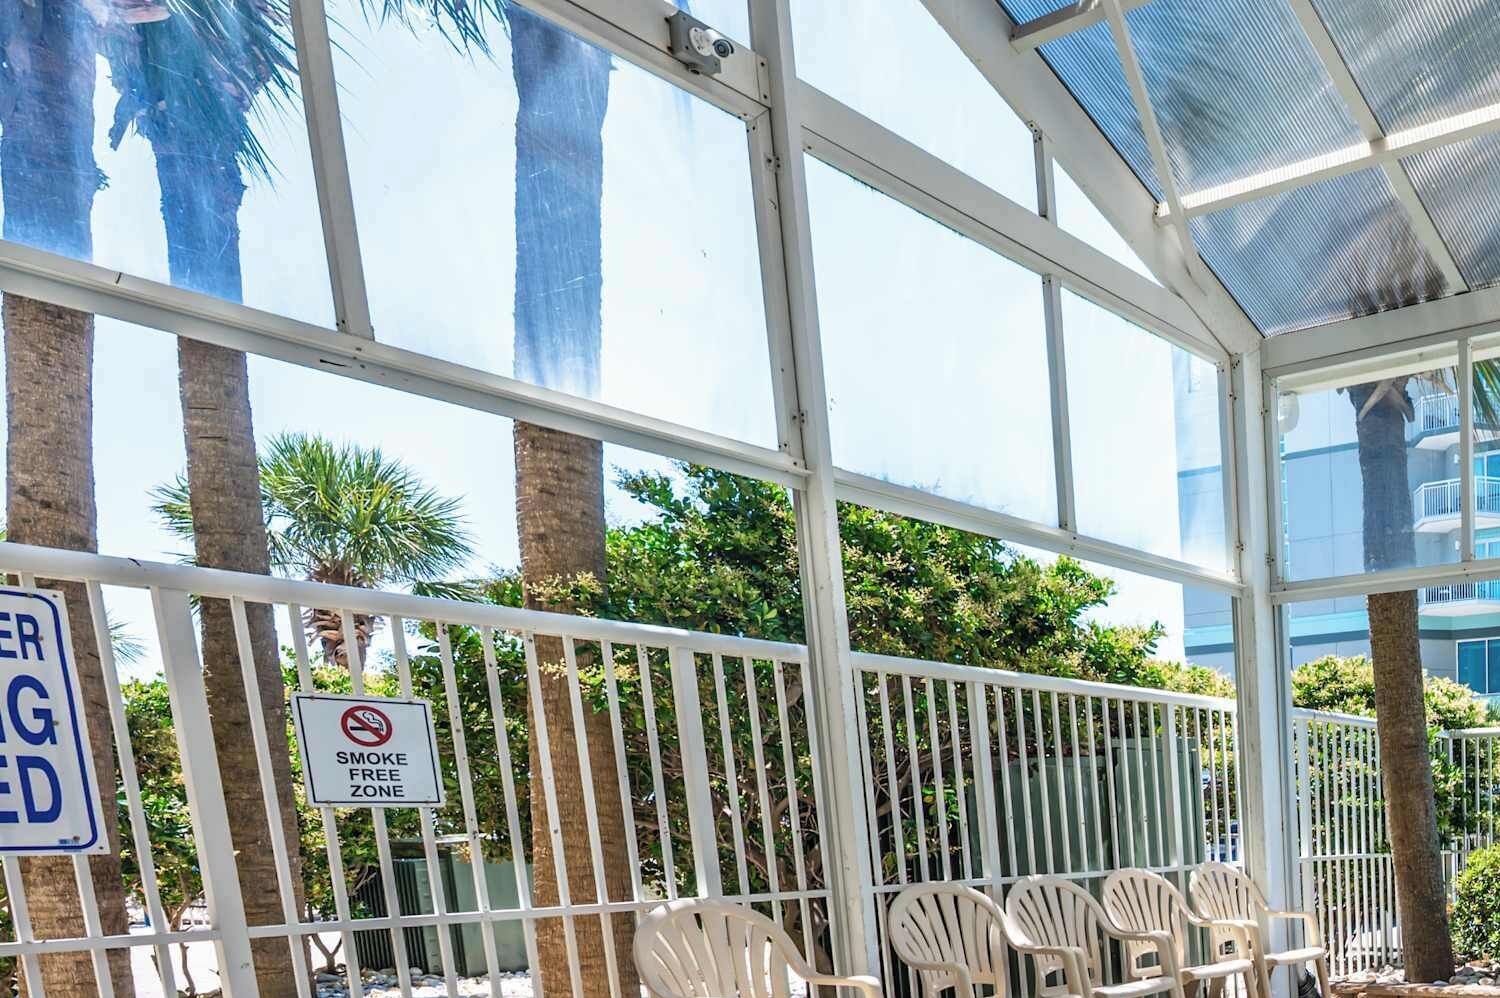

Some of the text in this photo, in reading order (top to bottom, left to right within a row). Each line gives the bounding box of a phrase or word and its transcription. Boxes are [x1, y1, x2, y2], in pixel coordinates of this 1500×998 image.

[336, 751, 408, 766] SMOKE
[349, 768, 401, 781] FREE
[350, 785, 404, 797] ZONE
